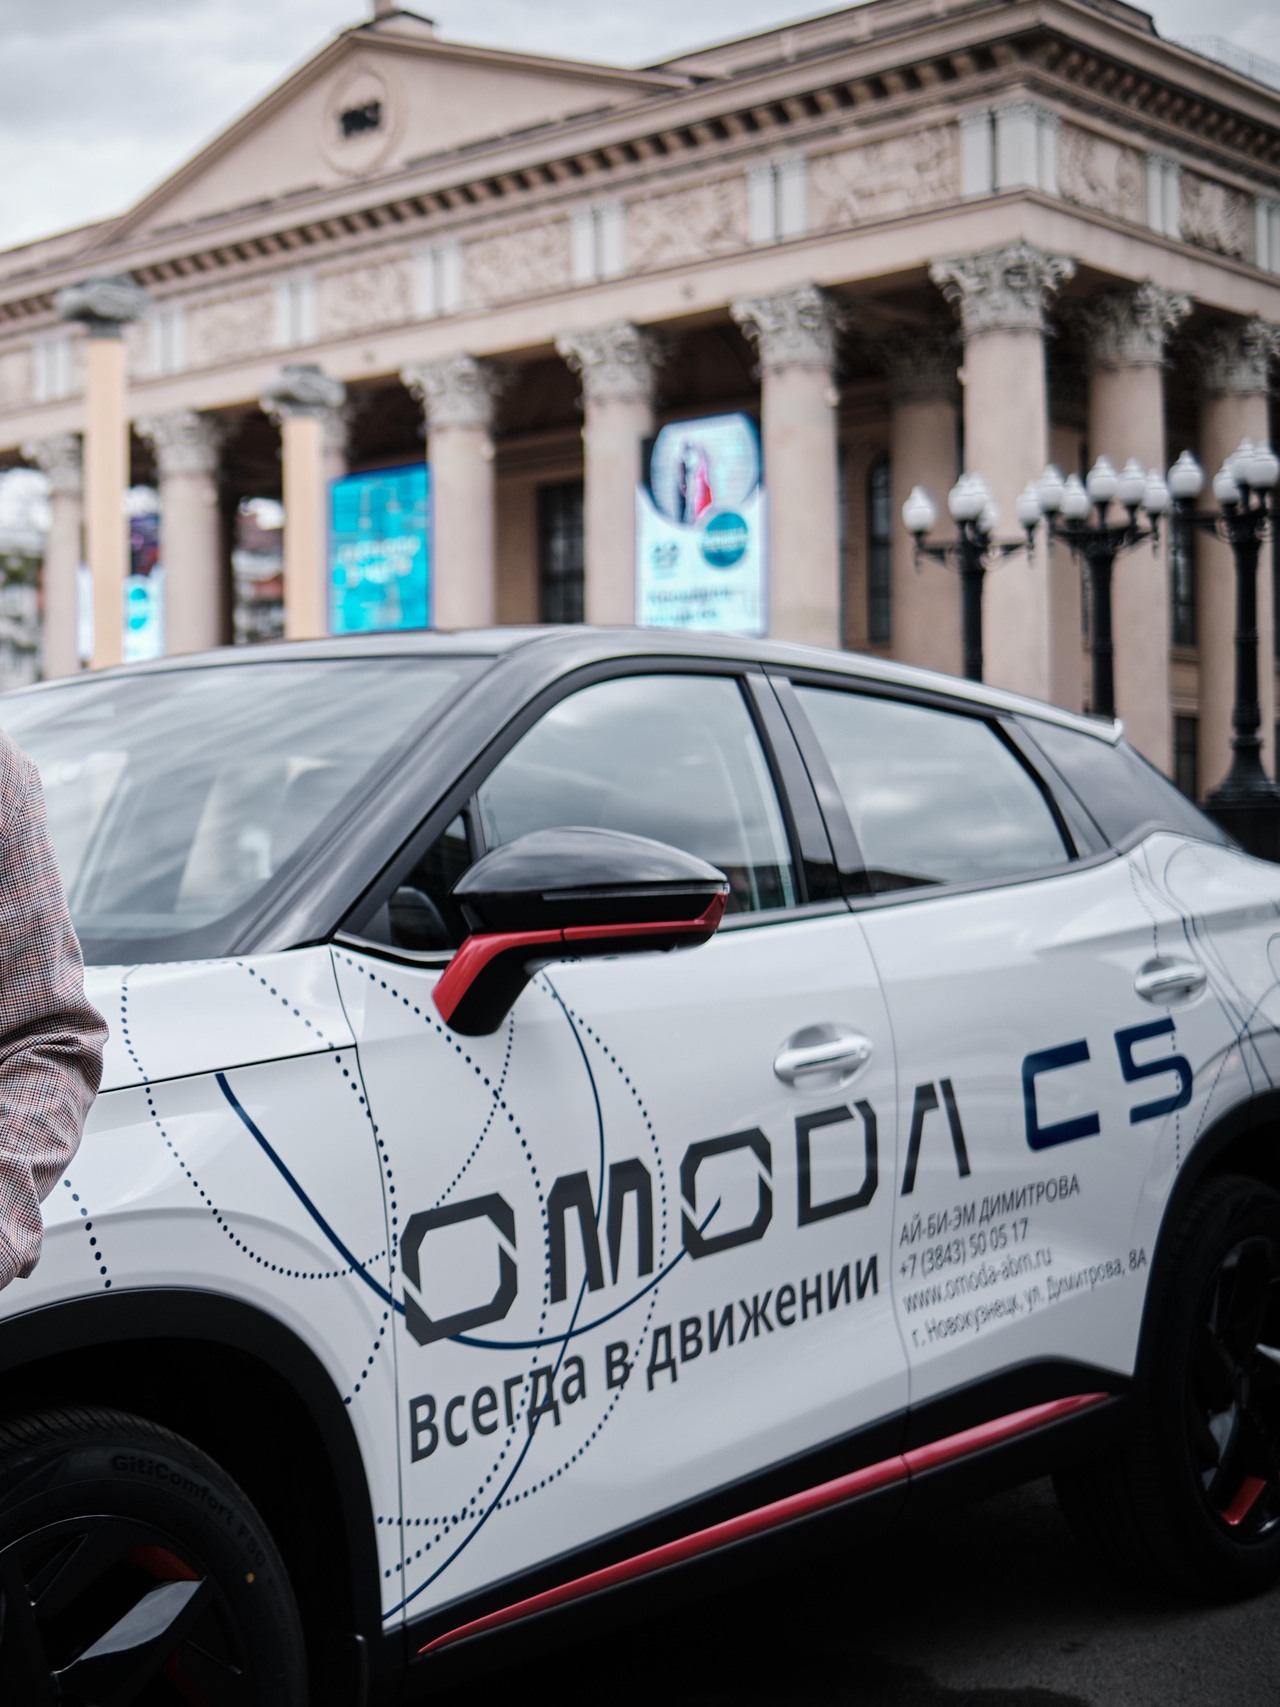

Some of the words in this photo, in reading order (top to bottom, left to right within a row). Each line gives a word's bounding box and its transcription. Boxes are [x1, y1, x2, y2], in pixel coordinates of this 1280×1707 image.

[399, 1078, 971, 1347] OMODA
[1021, 1016, 1193, 1153] C5
[898, 1202, 976, 1248] АЙ-БИ-ЭМ
[978, 1173, 1081, 1227] ДИМИТРОВА
[898, 1253, 917, 1279] +7
[920, 1238, 966, 1278] (3843)
[970, 1230, 987, 1259] 50
[989, 1222, 1008, 1251] 05
[1011, 1217, 1029, 1244] 17
[902, 1246, 1052, 1314] www.omoda-abm.ru
[1023, 1287, 1044, 1313] ул.
[1045, 1257, 1126, 1301] Димитрова,
[408, 1353, 587, 1464] Всегда
[604, 1340, 631, 1390] в
[646, 1253, 880, 1392] движении
[111, 1454, 235, 1526] GitiComfort
